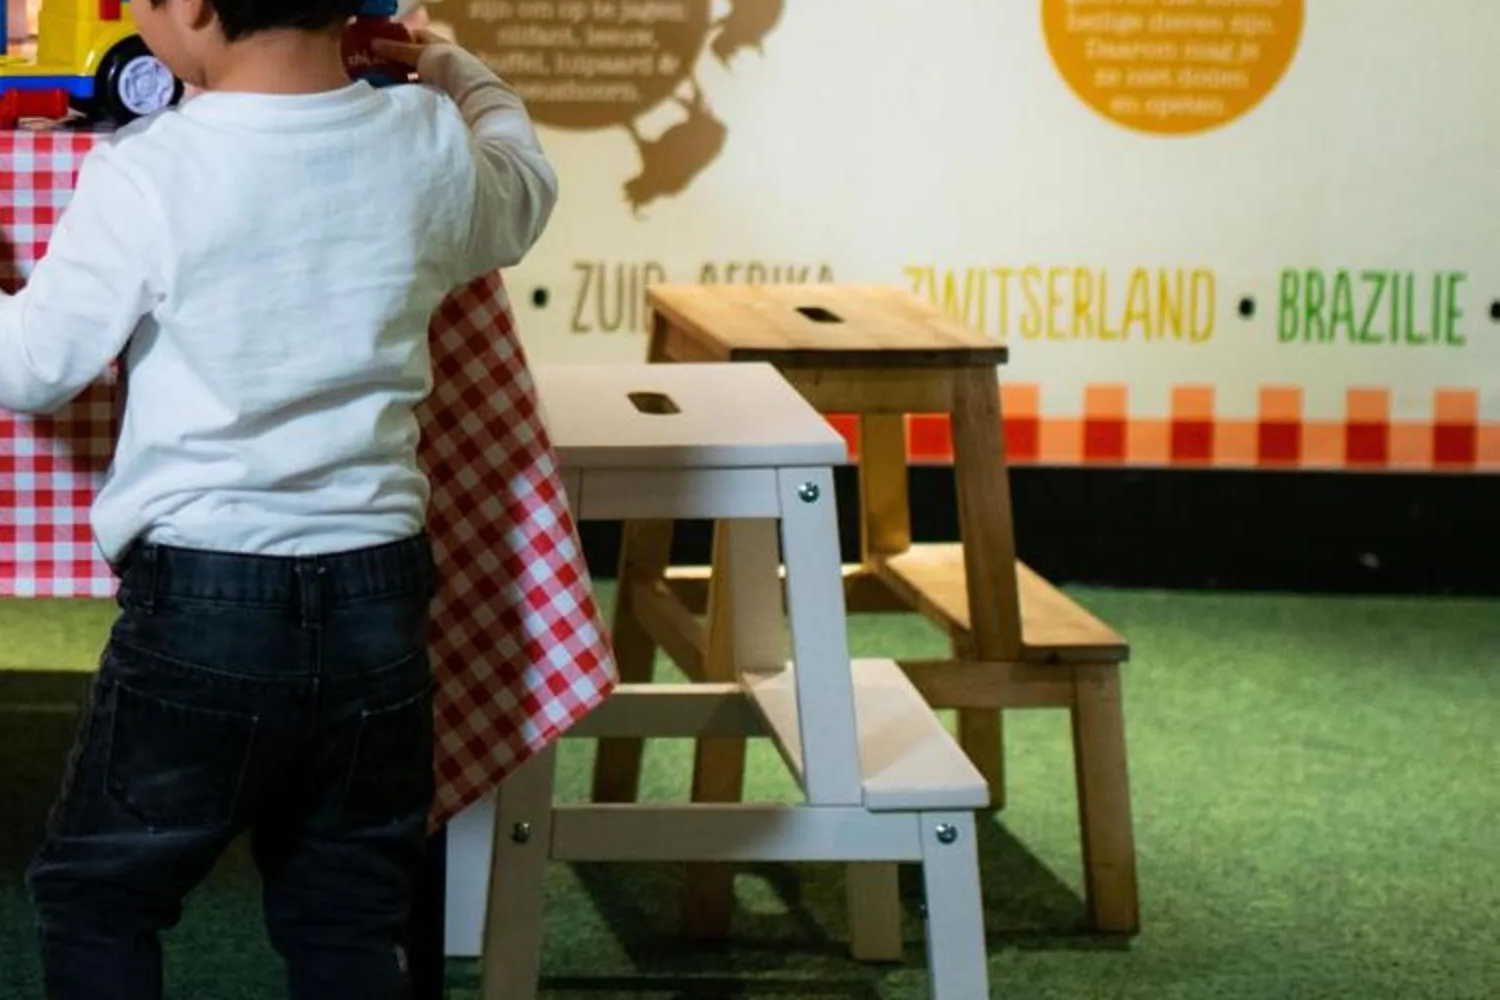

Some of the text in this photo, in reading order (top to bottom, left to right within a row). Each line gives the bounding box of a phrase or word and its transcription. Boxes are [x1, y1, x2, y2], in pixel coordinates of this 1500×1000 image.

[557, 1, 589, 25] op
[553, 50, 654, 78] luipaard
[1277, 267, 1467, 346] BRAZILIE
